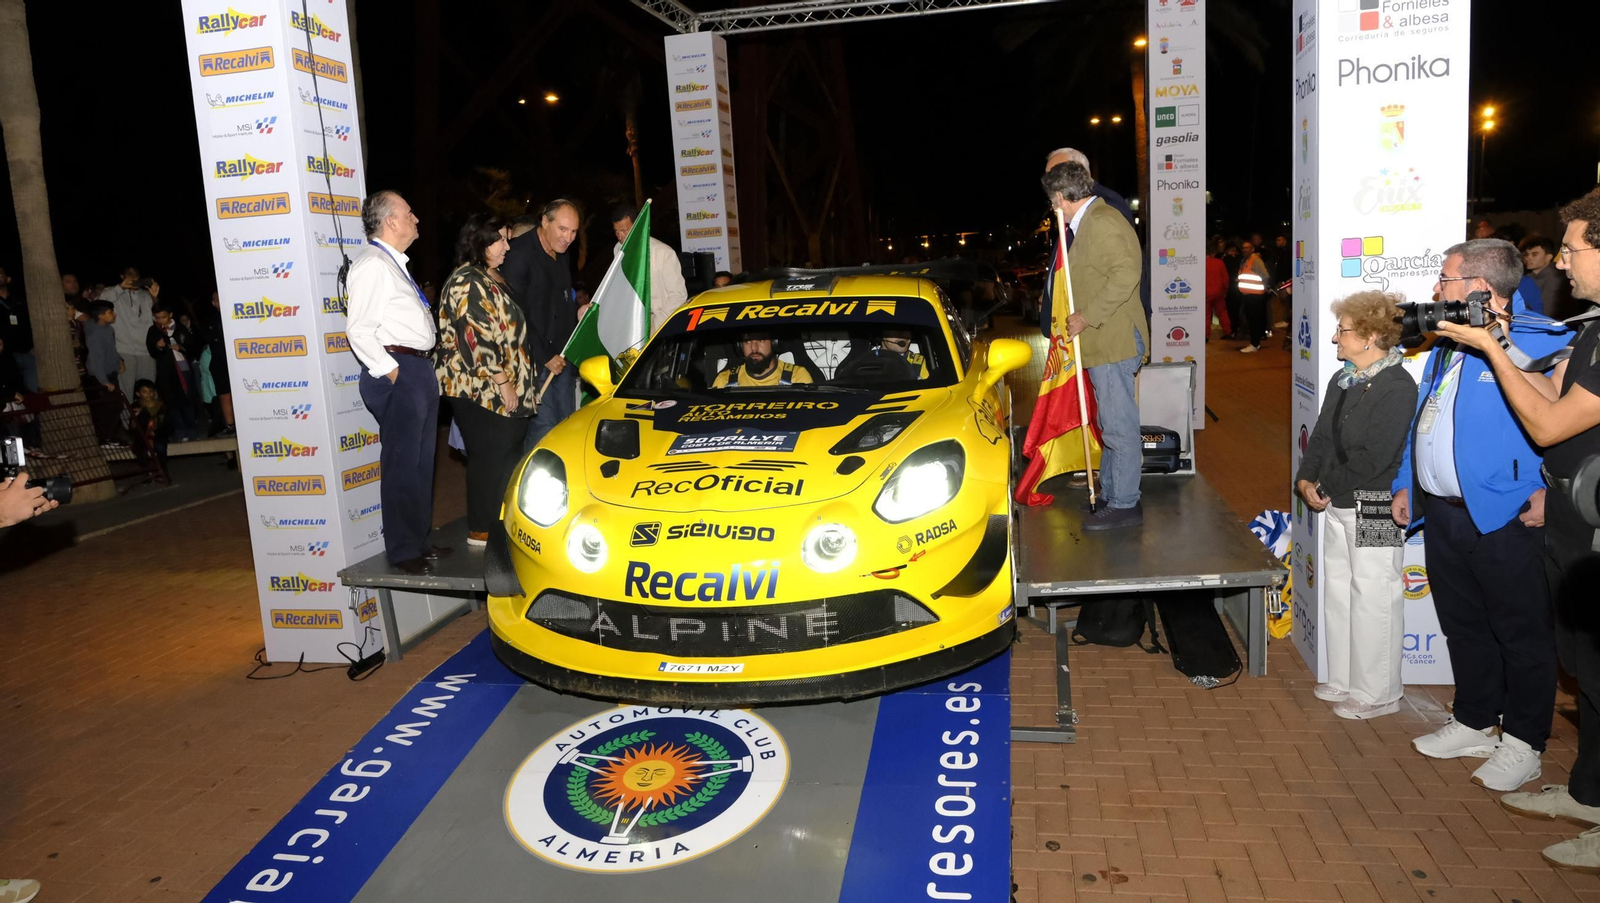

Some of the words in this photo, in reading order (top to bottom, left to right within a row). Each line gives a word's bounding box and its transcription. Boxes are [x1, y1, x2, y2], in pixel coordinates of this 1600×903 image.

[1382, 0, 1450, 14] Fornieles
[198, 13, 267, 31] Rallycar
[291, 10, 342, 42] Rallycar
[1383, 16, 1394, 29] &
[1400, 12, 1449, 28] albesa
[1394, 29, 1405, 37] de
[1410, 25, 1449, 36] seguros
[214, 52, 259, 71] Recalvi
[304, 56, 336, 77] Recalvi
[1338, 54, 1450, 86] Phonika
[226, 92, 274, 104] MICHELIN
[312, 96, 348, 110] MICHELIN
[1156, 132, 1199, 148] gasolia
[216, 158, 284, 175] Rallycar
[307, 156, 356, 178] Rallycar
[1157, 180, 1200, 191] Phonika
[232, 198, 274, 214] Recalvi
[320, 197, 350, 212] Recalvi
[242, 238, 290, 248] MICHELIN
[328, 237, 362, 245] MICHELIN
[1363, 248, 1444, 292] garcía
[1387, 269, 1441, 278] impresore
[234, 302, 300, 318] Rallycar
[686, 308, 704, 331] 1
[736, 300, 860, 320] Recalvi
[250, 340, 293, 354] Recalvi
[262, 381, 308, 389] MICHELIN
[344, 374, 361, 382] MICH
[682, 410, 732, 418] AUTO
[688, 401, 840, 412] TORREIRO
[678, 413, 787, 423] RECAMBIOS
[340, 432, 380, 449] Rallyca
[681, 441, 716, 449] COSTA
[252, 442, 318, 457] Rallycar
[352, 465, 380, 484] Recalvi
[268, 480, 310, 492] Recalvi
[630, 474, 804, 498] RecOficial
[360, 504, 382, 516] MICHE
[1378, 506, 1392, 514] YOR
[915, 519, 958, 546] RADSA
[518, 528, 541, 555] RADSA
[270, 576, 336, 592] Rallycar
[624, 560, 780, 602] Recalvi
[286, 614, 328, 625] Recalvi
[589, 611, 839, 642] ALPINE
[1402, 634, 1438, 651] ar
[670, 664, 701, 672] 7671
[707, 664, 741, 672] MZY
[555, 705, 721, 751] AUTOMOVIL
[734, 718, 776, 760] CLUB
[238, 673, 477, 900] www.garcia
[538, 834, 690, 864] ALMERIA
